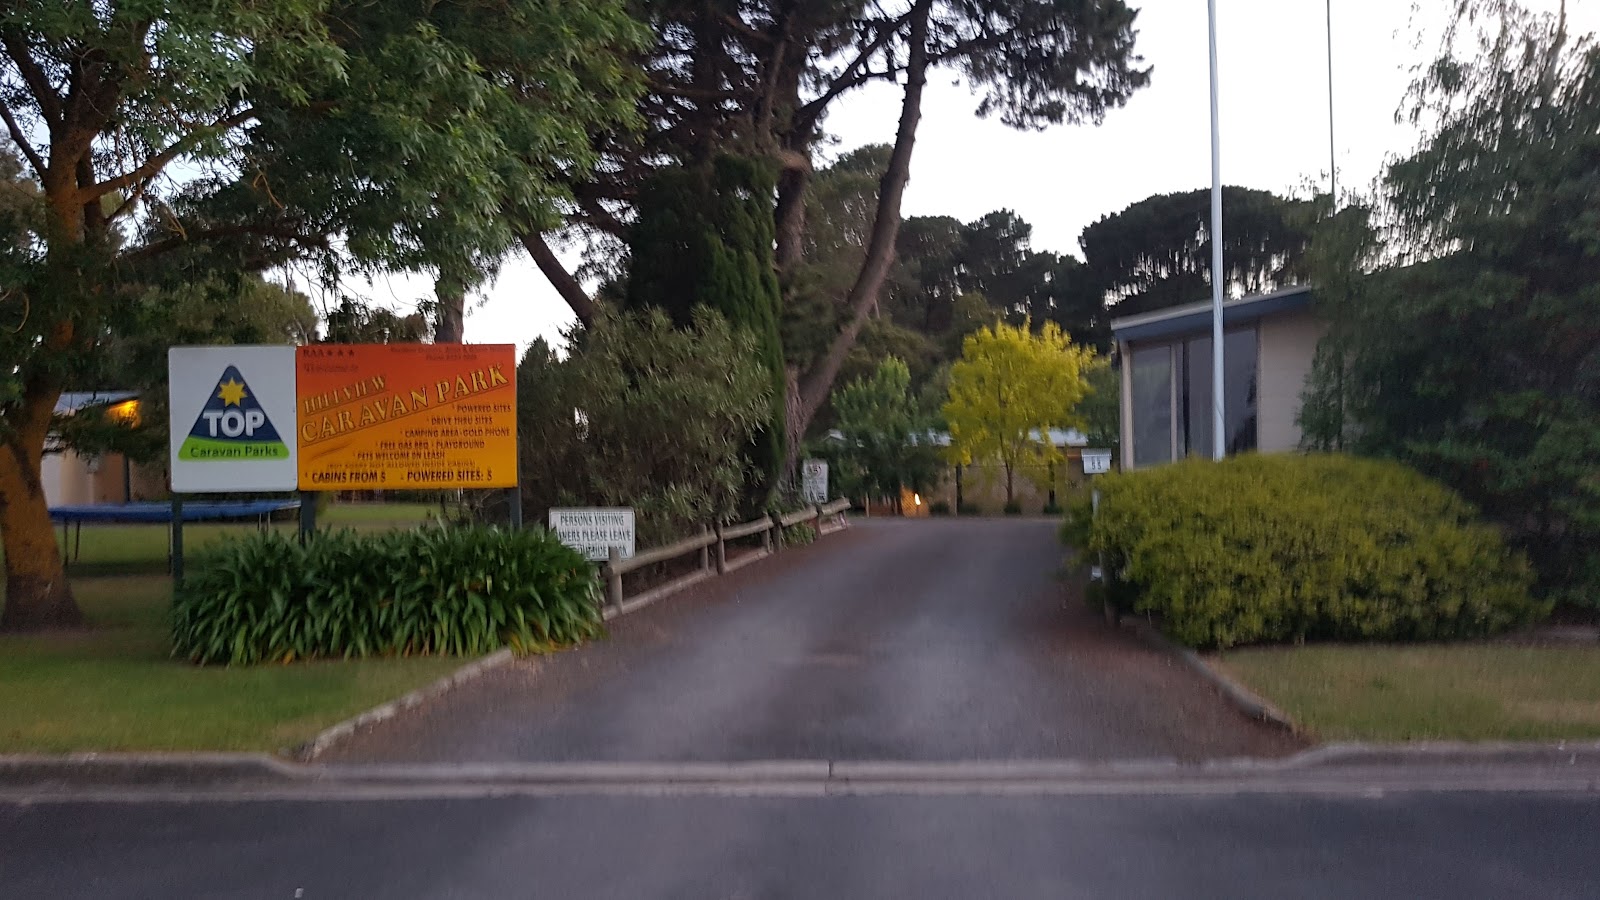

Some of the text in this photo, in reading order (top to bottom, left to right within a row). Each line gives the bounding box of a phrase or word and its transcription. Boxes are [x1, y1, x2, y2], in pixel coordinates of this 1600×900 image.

[301, 362, 509, 443] CARAVAN PARK
[456, 403, 511, 413] POWERED SITES
[202, 411, 265, 437] TOP
[431, 416, 493, 426] DRIVE THRU SITES
[405, 429, 438, 438] CAMPING
[485, 428, 510, 436] PHONE
[190, 444, 278, 457] Caravan Parks
[398, 442, 412, 450] GAS
[436, 440, 485, 450] PLAYGROUND
[358, 452, 373, 460] PETS
[376, 452, 409, 460] WELCOME
[424, 450, 445, 460] LEASH
[312, 472, 347, 483] CABINS
[350, 471, 378, 483] FROM
[407, 470, 454, 482] POWERED
[457, 470, 484, 481] SITES:
[560, 512, 624, 526] PERSONS VISITING
[582, 530, 608, 542] PLEASE
[610, 530, 632, 542] LEAVE
